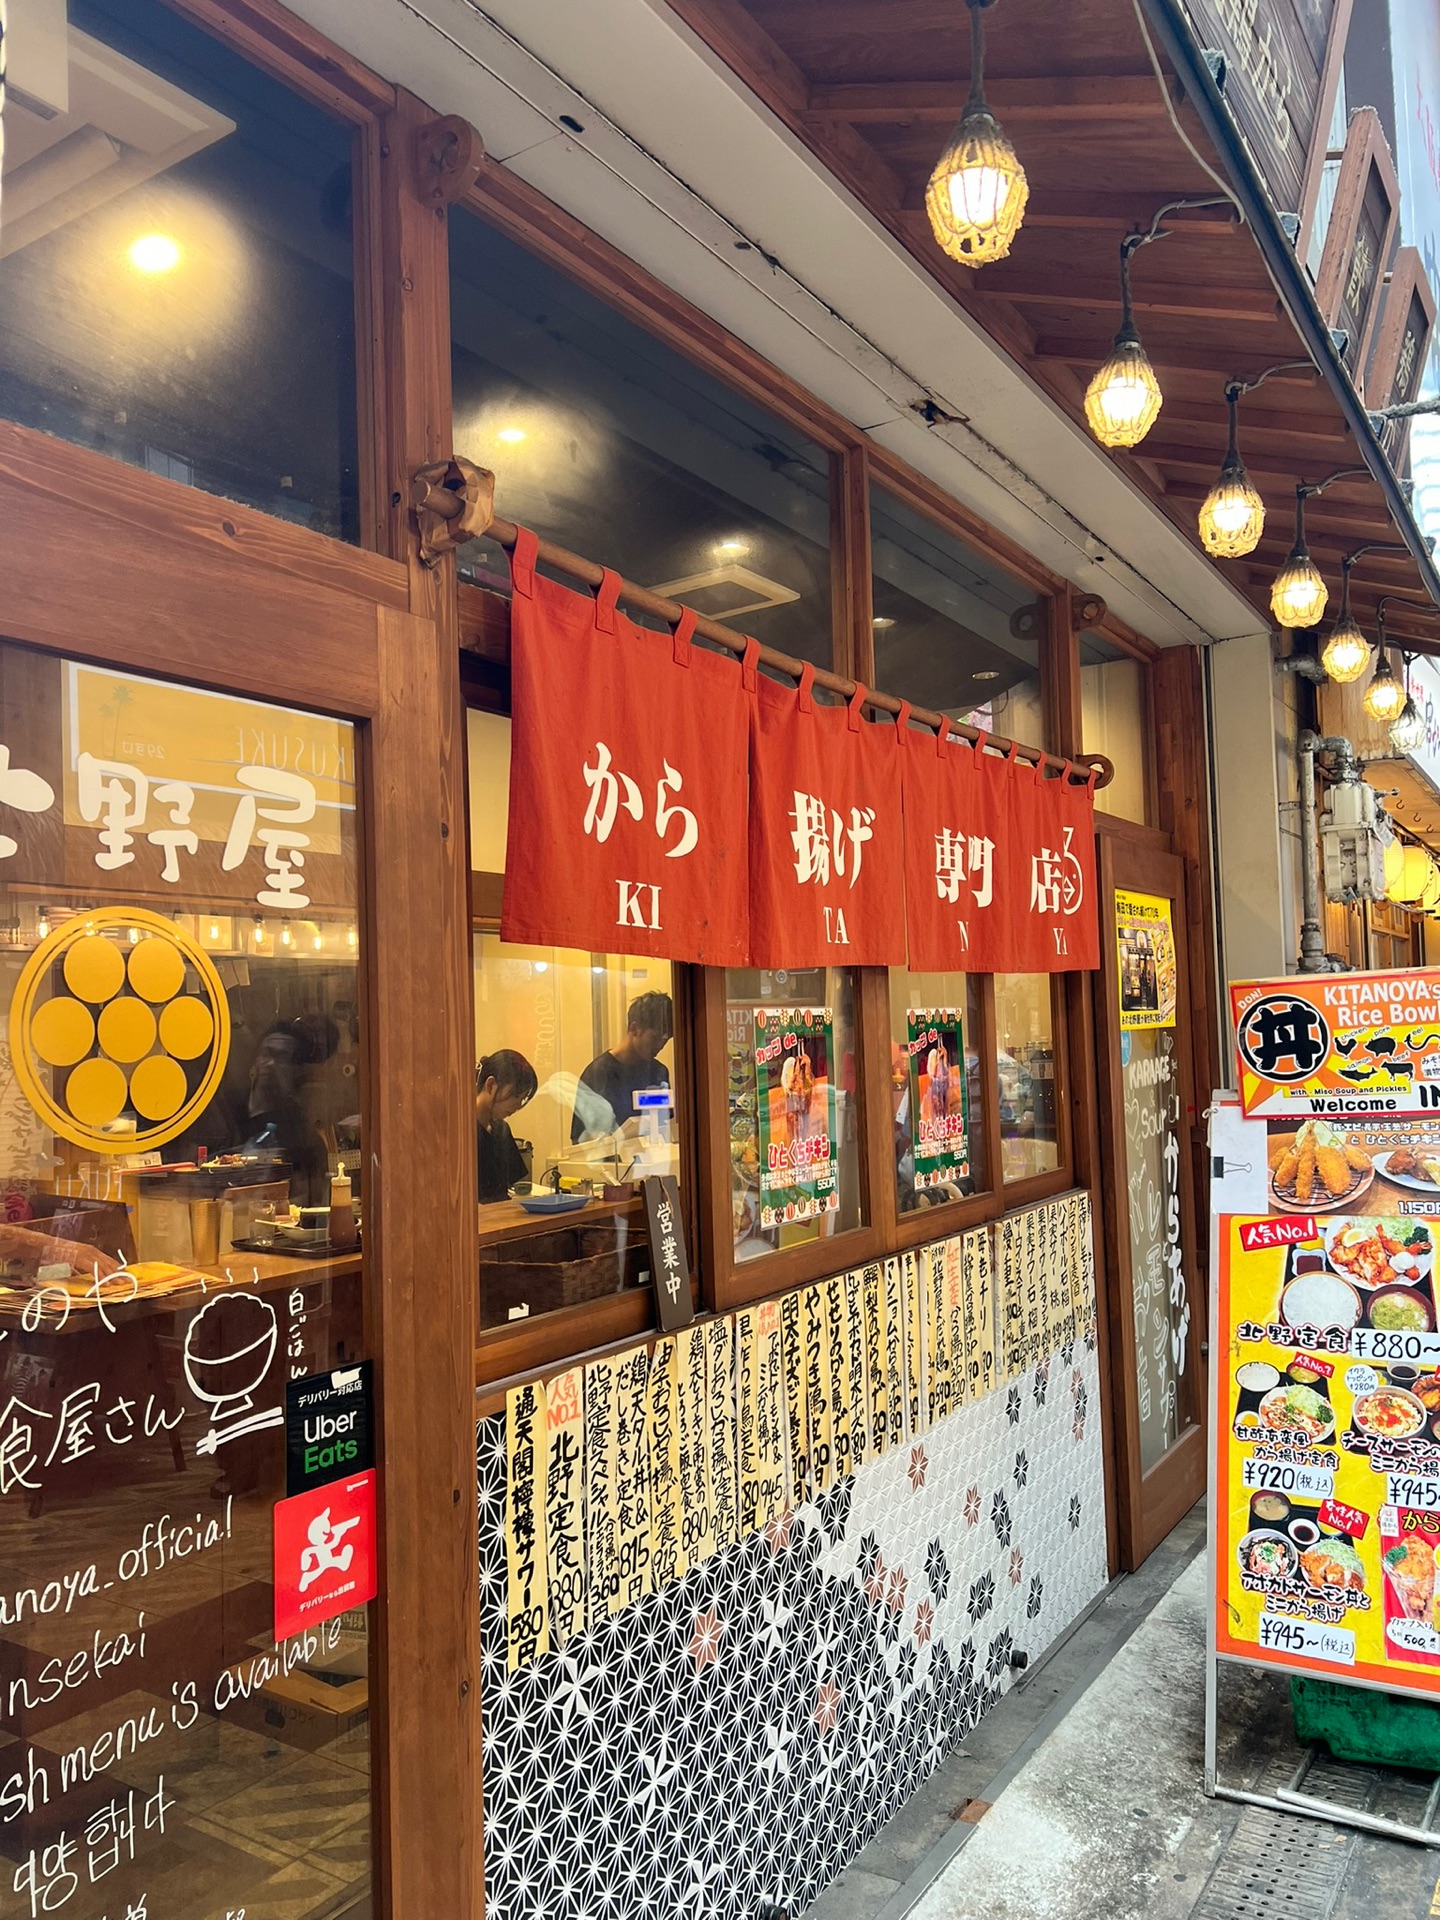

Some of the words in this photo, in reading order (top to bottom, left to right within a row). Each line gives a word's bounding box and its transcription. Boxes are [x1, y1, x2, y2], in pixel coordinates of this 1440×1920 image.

[582, 741, 700, 859] から
[787, 788, 877, 890] 揚げ
[933, 826, 997, 909] 専門
[615, 879, 664, 930] KI
[823, 906, 850, 945] TA
[1237, 987, 1263, 1011] DON!
[1338, 1007, 1383, 1027] Rice
[1341, 1027, 1367, 1040] chicken
[1374, 1026, 1390, 1036] pork
[1412, 1027, 1423, 1036] eel
[784, 1032, 797, 1050] de
[1128, 1055, 1171, 1090] KARAAGE
[1347, 1057, 1371, 1069] salmon
[1392, 1051, 1409, 1062] beef
[1310, 1098, 1397, 1113] Welcome
[1314, 1087, 1333, 1095] Miso
[1335, 1086, 1357, 1095] Soup
[1359, 1086, 1374, 1094] and
[1375, 1085, 1407, 1093] Pickles
[1141, 1108, 1167, 1139] Sour
[767, 1134, 831, 1171] ひとくちチキン
[1350, 1135, 1360, 1145] と
[1247, 1218, 1315, 1246] 人気No.1
[657, 1201, 681, 1305] 営業中
[1164, 1131, 1190, 1375] からあげ
[0, 1249, 138, 1342] のや
[288, 1288, 308, 1380] 白ごはん
[1239, 1322, 1349, 1351] 北野定食
[1346, 1374, 1376, 1383] トッピング
[1348, 1367, 1365, 1375] イクラ
[550, 1373, 579, 1402] 人気
[304, 1409, 357, 1443] Uber
[1236, 1426, 1309, 1447] 甘酢南蛮風
[304, 1438, 358, 1474] Eats
[587, 1363, 614, 1529] 北野定食スペシャル
[615, 1361, 635, 1536] だし巻き定食
[677, 1382, 693, 1515] とろろご飯定食
[1254, 1446, 1340, 1469] から揚げ定食
[1244, 1461, 1295, 1489] ¥920
[546, 1430, 579, 1576] 北野定食
[1326, 1500, 1363, 1524] 女性人気
[681, 1506, 709, 1566] 880円
[1328, 1513, 1352, 1530] No.1
[619, 1531, 650, 1598] 815円
[1241, 1573, 1371, 1609] アボカドサーモン丼と
[1265, 1595, 1346, 1622] ミニから揚げ
[510, 1606, 543, 1667] 580円
[0, 1611, 146, 1717] nsekai
[61, 1707, 165, 1793] menu
[171, 1681, 200, 1731] is
[214, 1616, 341, 1711] available
